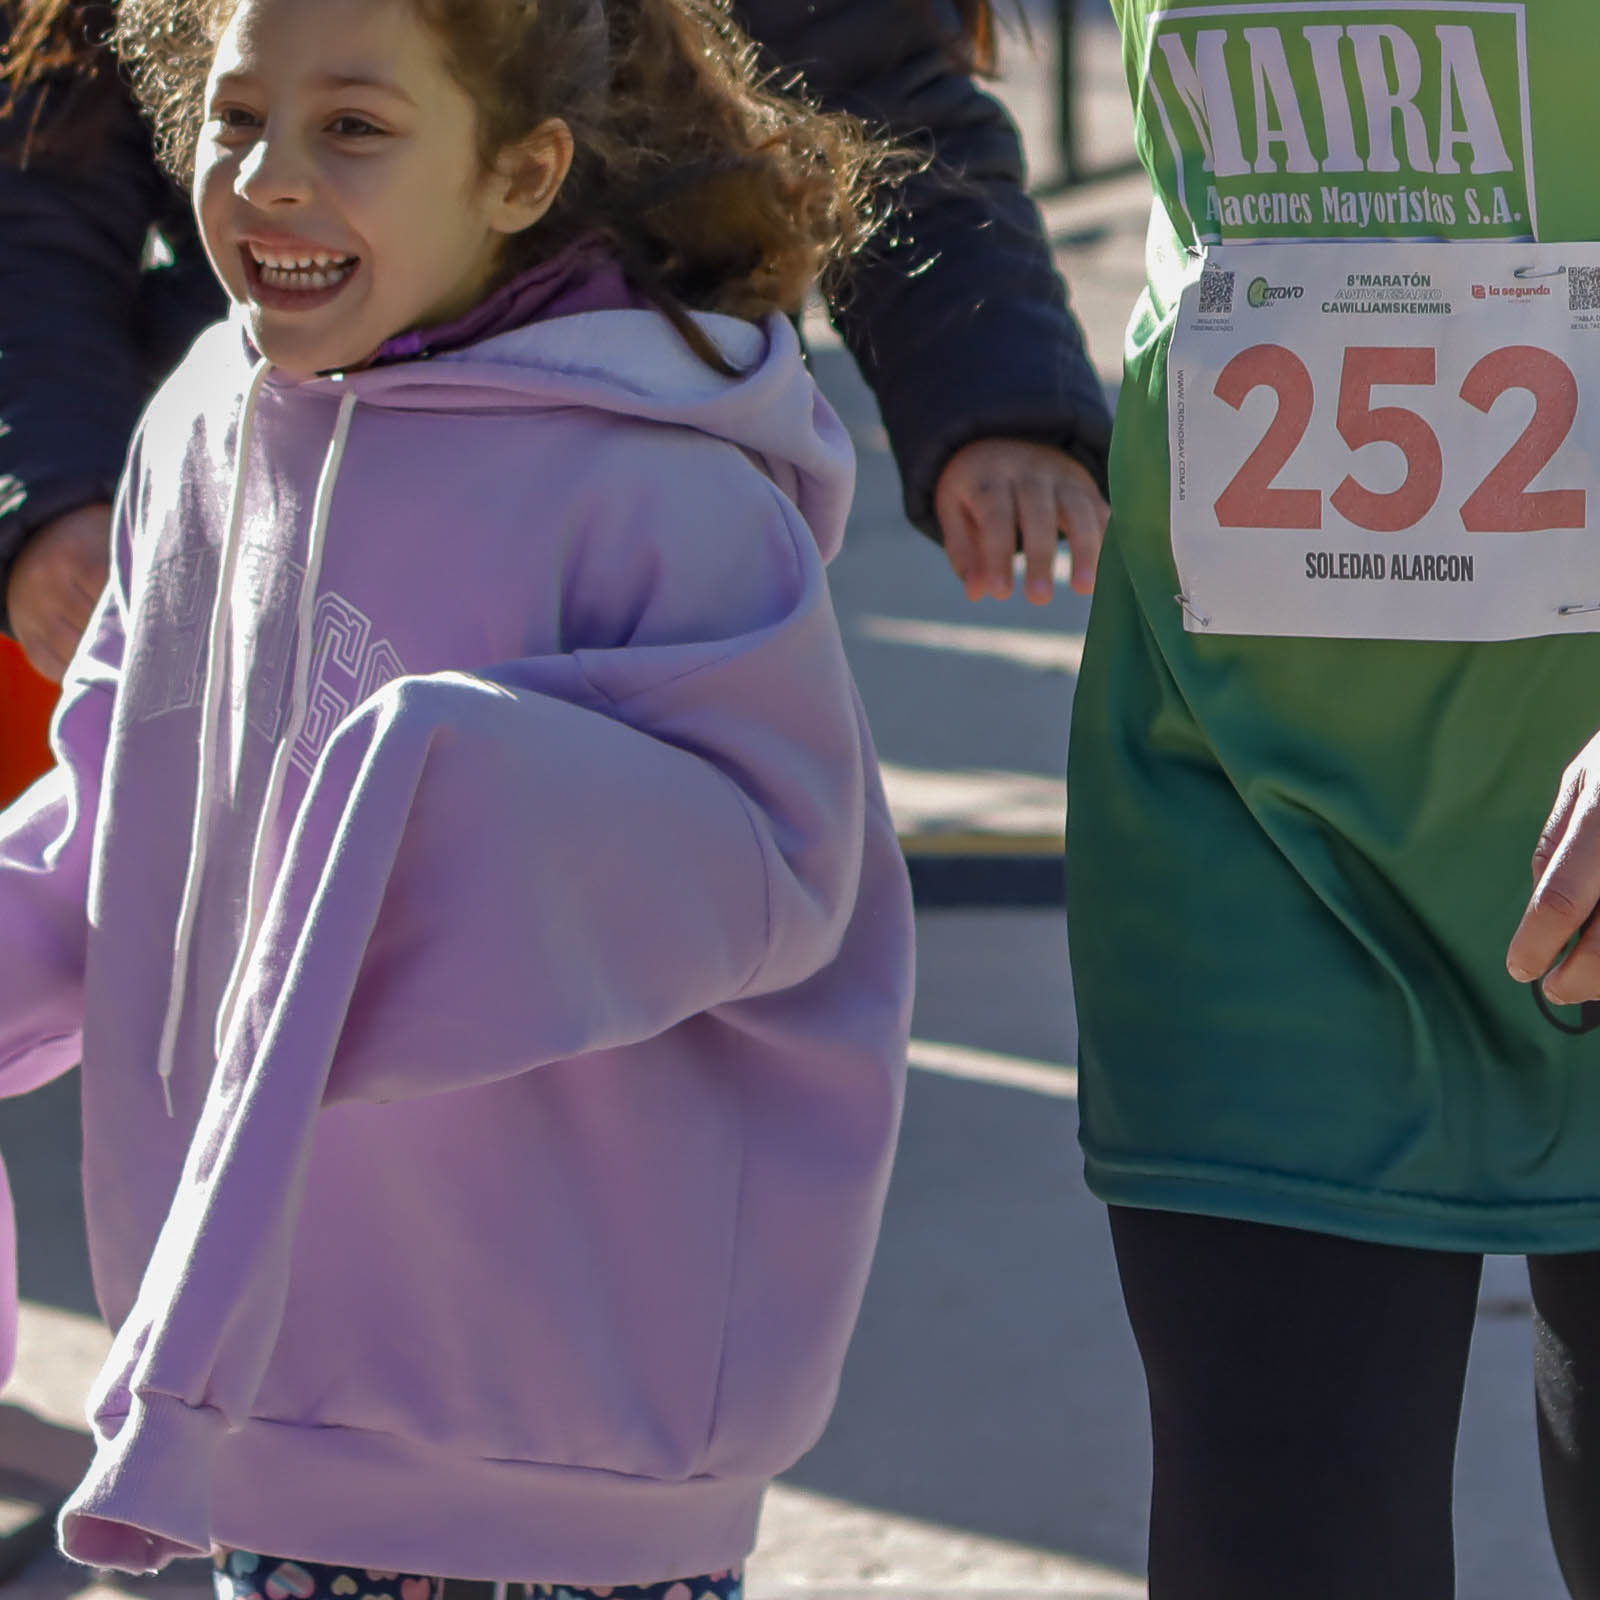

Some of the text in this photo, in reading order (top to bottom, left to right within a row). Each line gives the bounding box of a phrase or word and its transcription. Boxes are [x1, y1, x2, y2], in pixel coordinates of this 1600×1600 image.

[1319, 185, 1457, 229] Mayoristas
[1464, 187, 1522, 226] S.A.
[1488, 284, 1551, 298] la segunda
[1321, 302, 1452, 314] CAWILLIAMSKEMMIS
[1213, 343, 1586, 533] 252
[1305, 552, 1474, 582] SOLEDAD ALARCON
